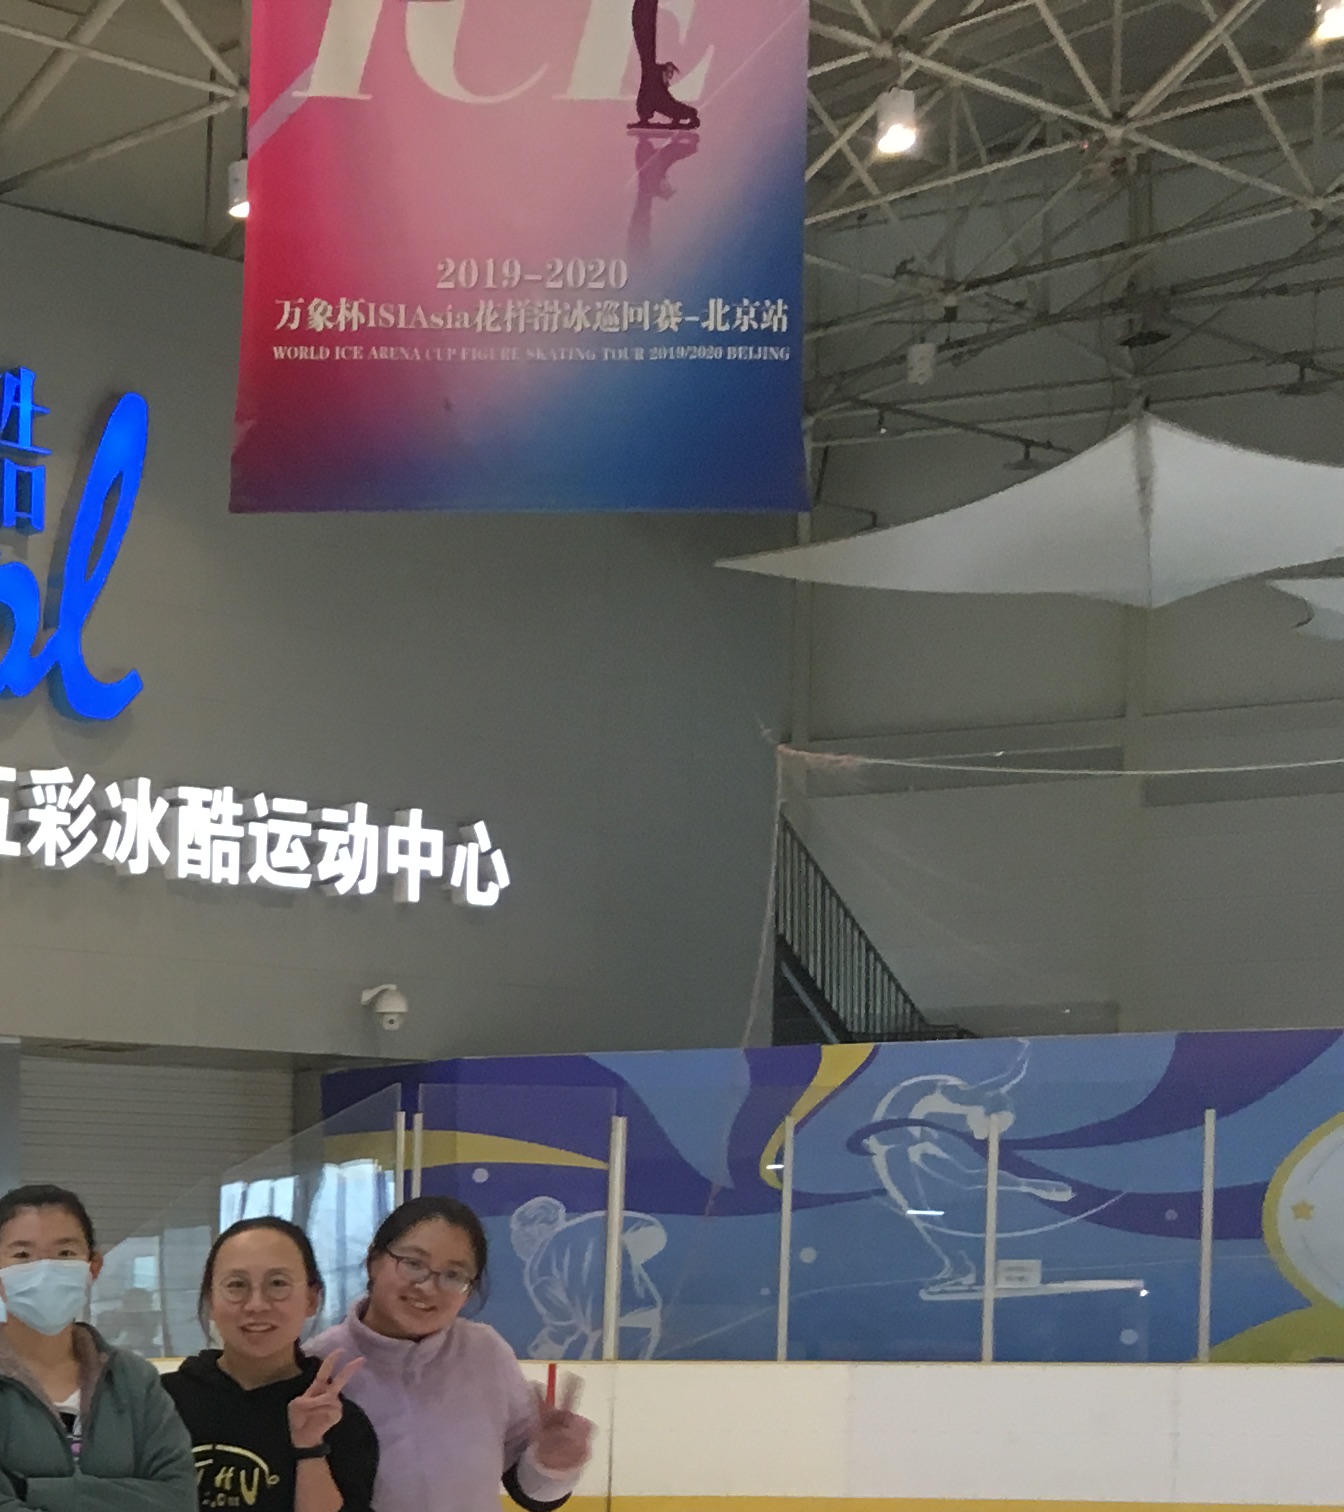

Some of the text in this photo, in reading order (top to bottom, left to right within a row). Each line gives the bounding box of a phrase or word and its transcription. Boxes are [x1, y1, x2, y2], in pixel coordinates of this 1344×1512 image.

[436, 257, 629, 290] 2019-2020
[273, 346, 330, 361] WORLD
[335, 346, 363, 361] ICE
[368, 346, 422, 361] ARENA
[602, 346, 645, 361] TOUR
[726, 346, 791, 361] BEIJING
